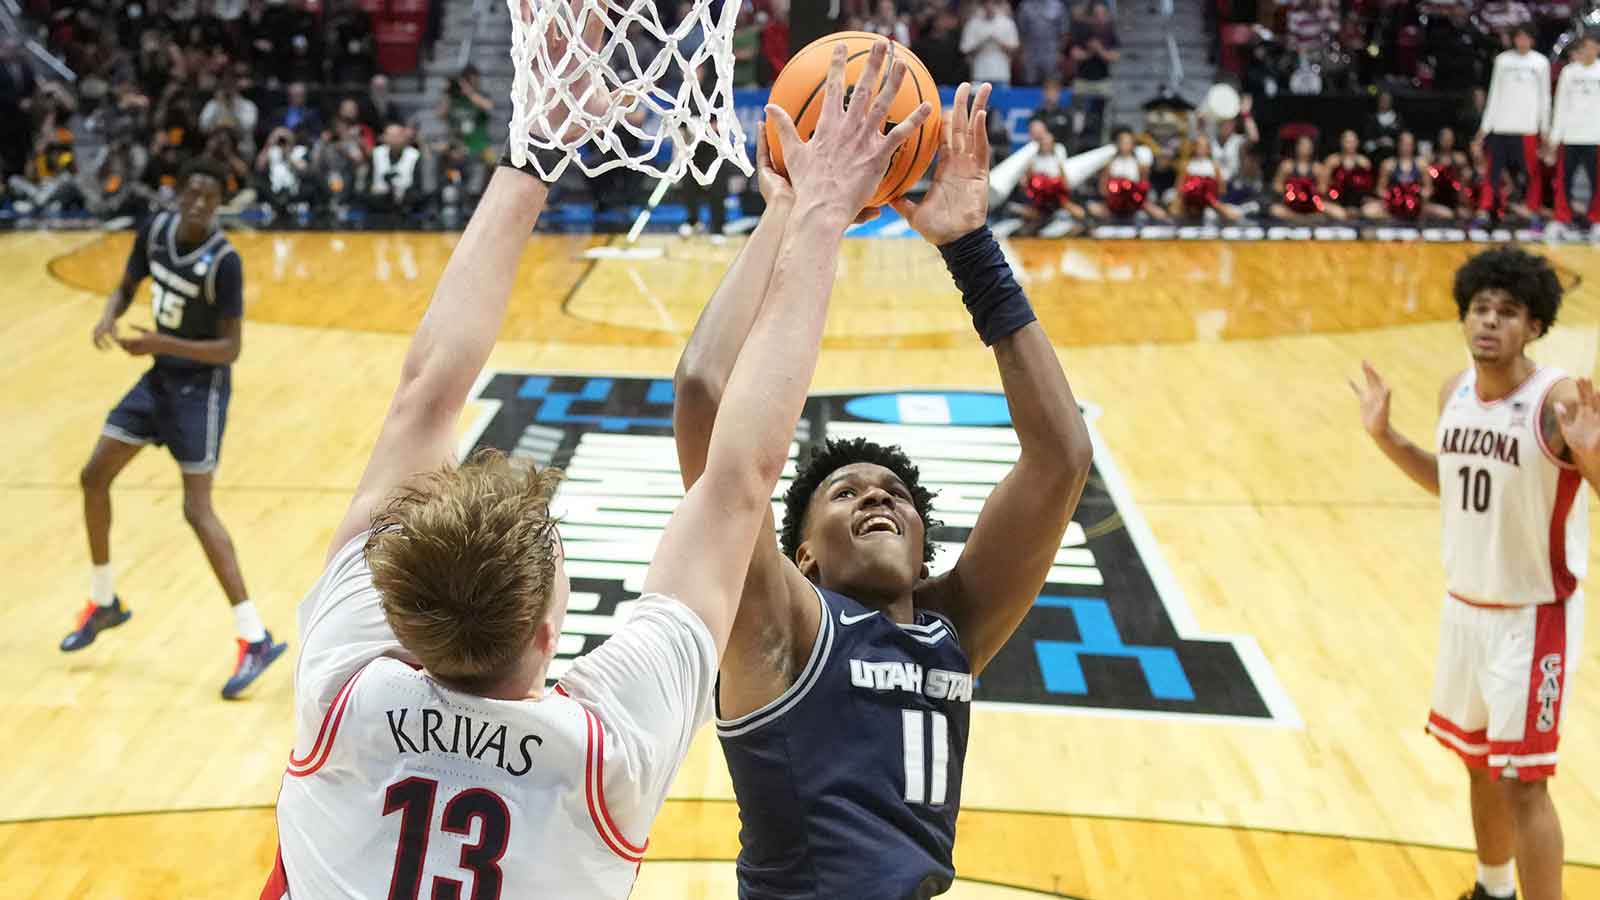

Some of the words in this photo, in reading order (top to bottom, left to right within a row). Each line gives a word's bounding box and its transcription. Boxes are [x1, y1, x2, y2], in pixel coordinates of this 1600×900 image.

[1441, 428, 1521, 467] ARIZONA
[1459, 466, 1492, 513] 10
[849, 659, 923, 694] UTAH
[924, 668, 972, 702] STA
[386, 707, 543, 777] KRIVAS
[902, 709, 949, 805] 11
[382, 776, 511, 900] 13
